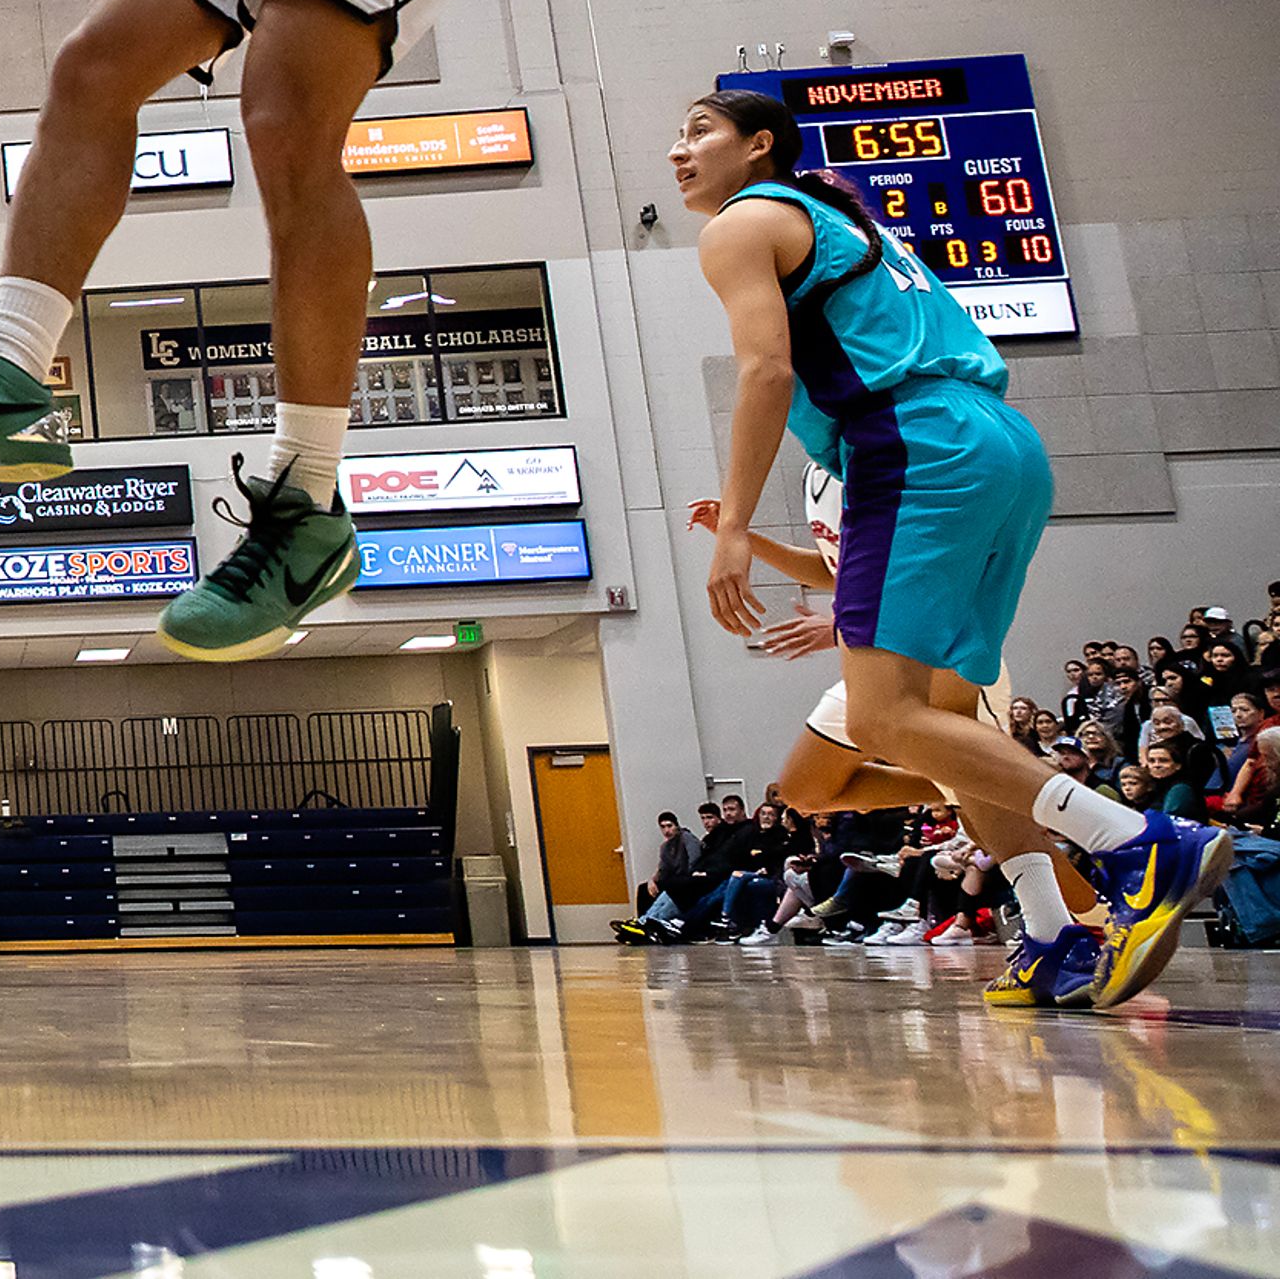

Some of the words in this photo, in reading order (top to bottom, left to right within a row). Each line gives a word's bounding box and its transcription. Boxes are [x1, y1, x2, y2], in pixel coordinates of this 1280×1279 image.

[807, 78, 943, 106] NOVEMBER
[419, 139, 447, 152] DDS
[853, 121, 942, 160] 6:55
[964, 157, 1022, 176] GUEST
[869, 173, 913, 186] PERIOD
[886, 190, 906, 217] 2
[980, 179, 1033, 215] 60
[930, 223, 954, 236] PTS
[1006, 218, 1046, 231] FOULS
[947, 239, 969, 267] 0
[981, 241, 998, 262] 3
[1021, 235, 1052, 262] 10
[974, 267, 1009, 279] T.O.L.
[149, 333, 180, 366] LC
[188, 342, 274, 360] WOMEN'S
[360, 335, 416, 351] BALL
[18, 482, 123, 504] Clearwater
[124, 478, 178, 501] River
[350, 470, 439, 503] POE
[36, 503, 92, 517] CASINO
[94, 500, 111, 517] &
[113, 500, 165, 513] LODGE
[68, 549, 189, 576] SPORTS
[388, 543, 490, 565] CANNER
[404, 563, 477, 573] FINANCIAL
[59, 584, 88, 596] PLAY
[90, 583, 124, 595] HERE!
[133, 581, 194, 592] KOZE.COM
[163, 718, 178, 735] M
